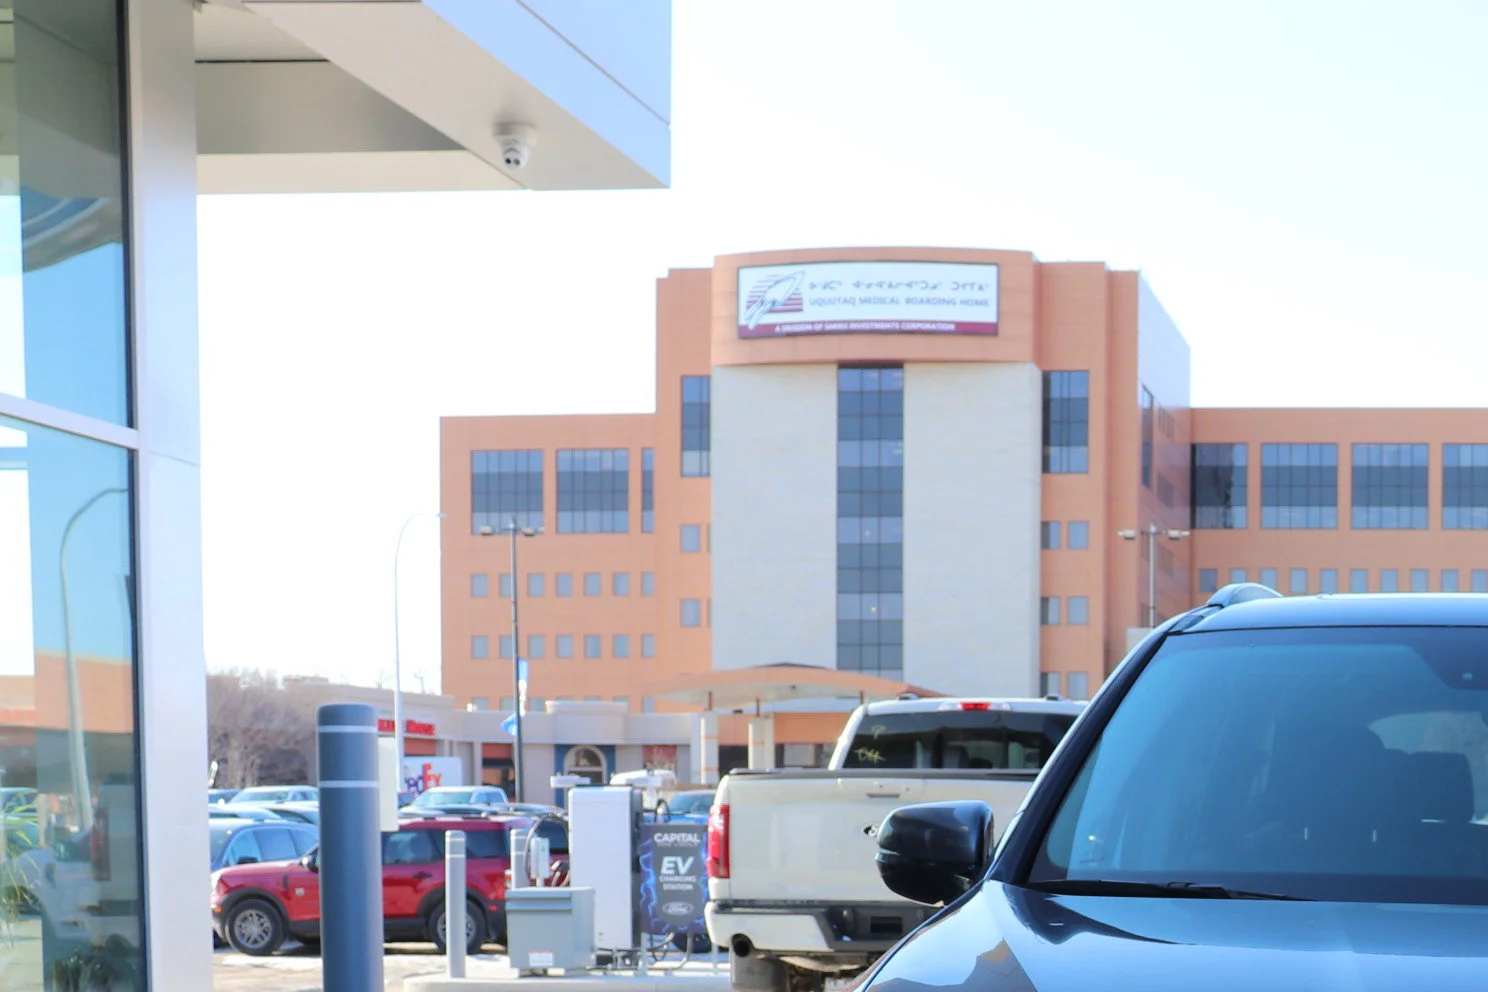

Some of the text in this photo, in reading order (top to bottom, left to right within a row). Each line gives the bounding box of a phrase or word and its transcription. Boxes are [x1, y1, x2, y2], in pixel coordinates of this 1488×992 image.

[858, 297, 900, 305] MEDICAL
[905, 297, 957, 306] BOARDING
[959, 298, 989, 307] HOME
[653, 832, 700, 843] CAPITAL
[660, 855, 695, 875] EV
[662, 883, 694, 891] STATION
